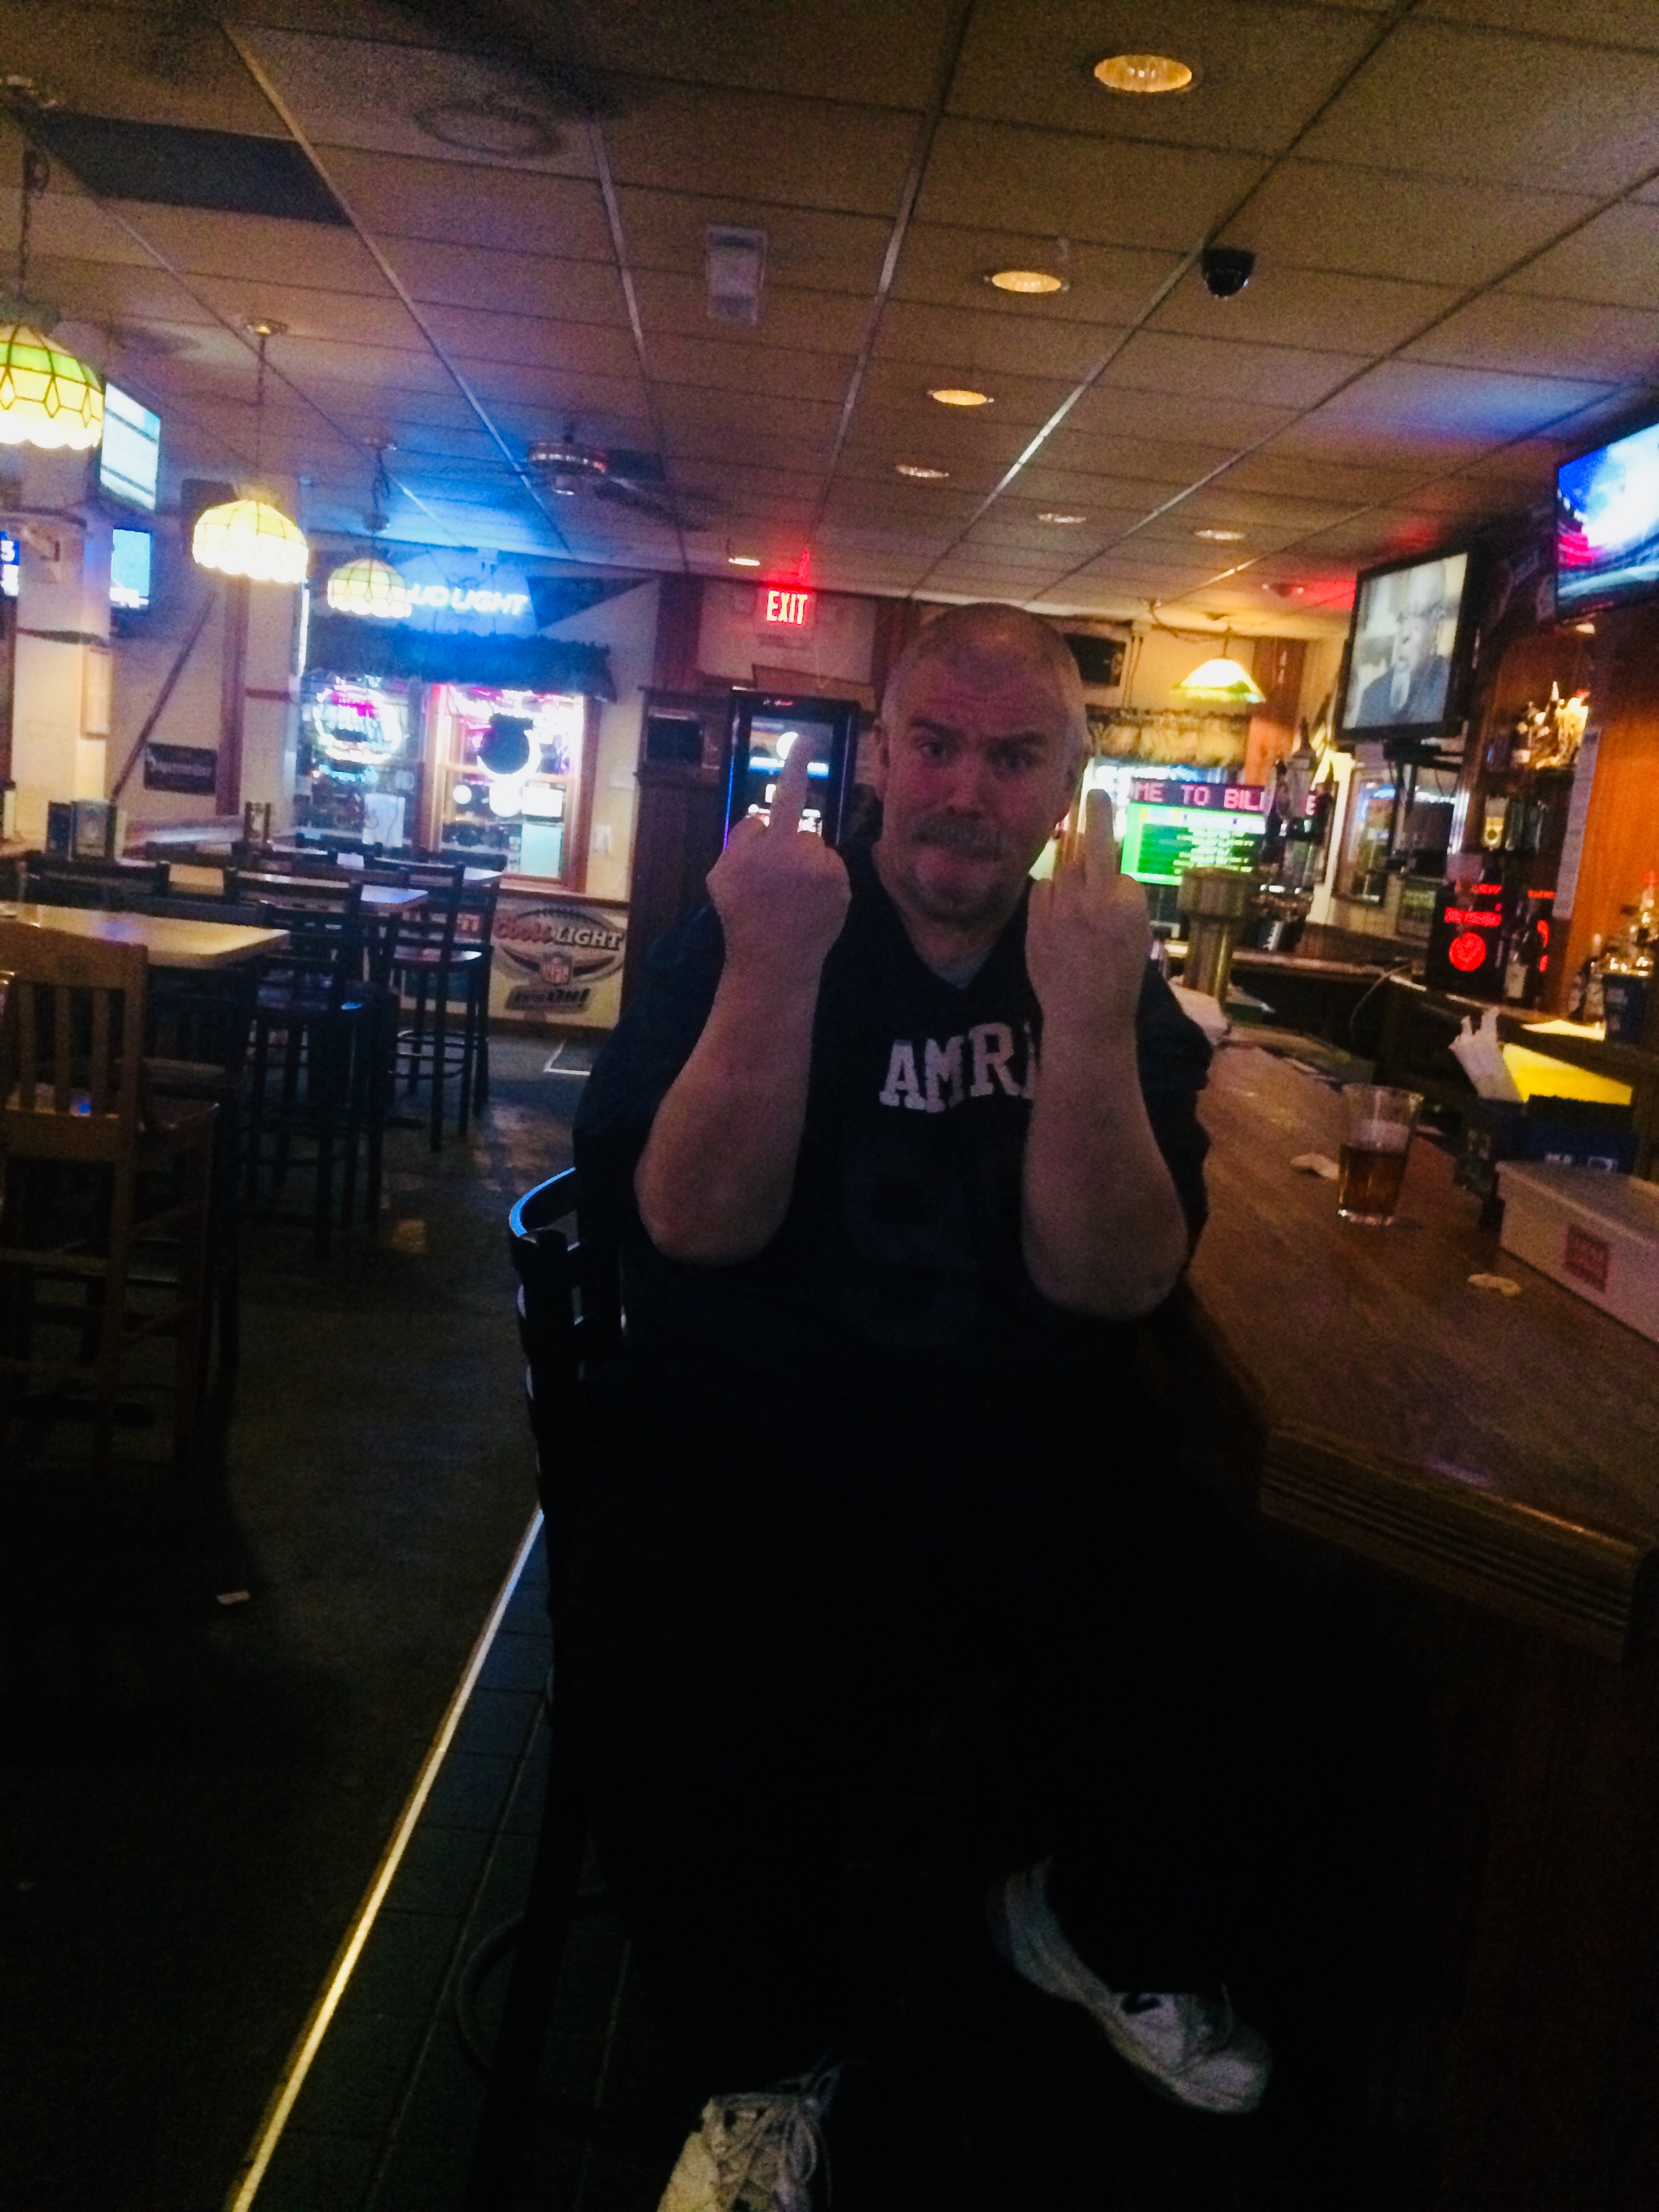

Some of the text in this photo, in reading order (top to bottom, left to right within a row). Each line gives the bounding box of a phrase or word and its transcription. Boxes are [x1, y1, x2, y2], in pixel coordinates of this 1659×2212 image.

[451, 587, 528, 615] LIGHT
[766, 590, 808, 625] EXIT
[1181, 784, 1211, 806] TO
[556, 926, 623, 950] LIGHT
